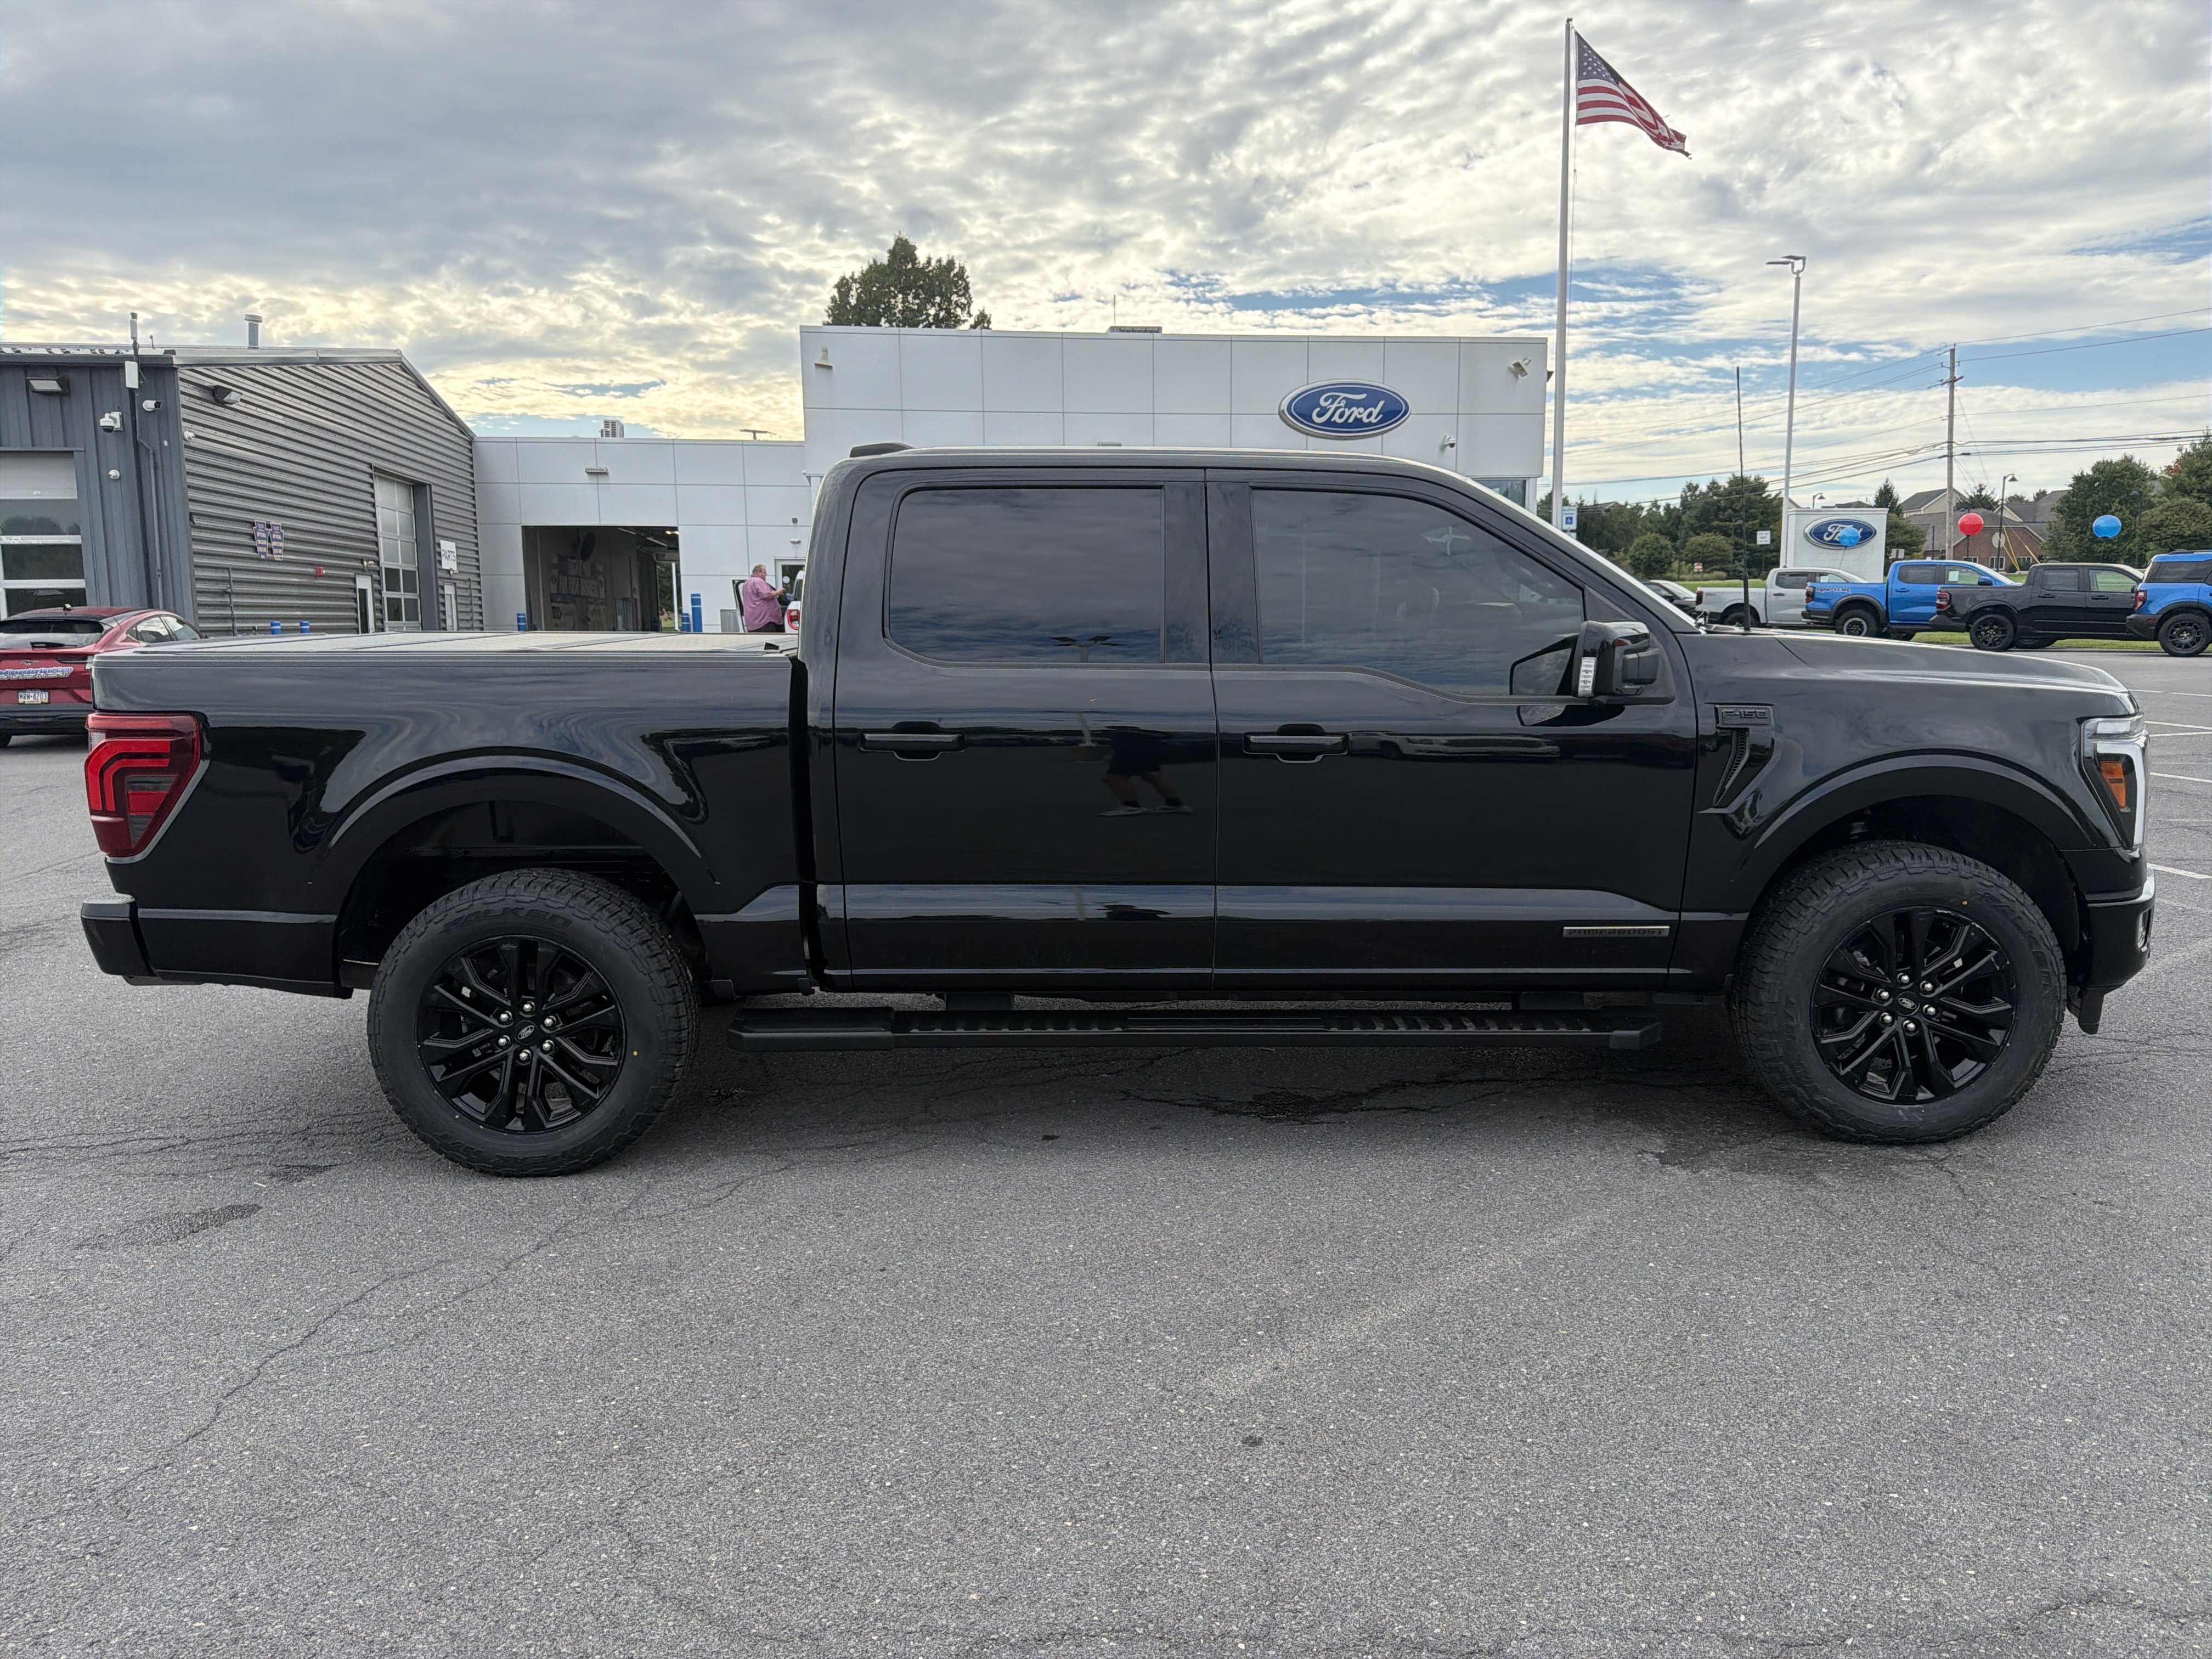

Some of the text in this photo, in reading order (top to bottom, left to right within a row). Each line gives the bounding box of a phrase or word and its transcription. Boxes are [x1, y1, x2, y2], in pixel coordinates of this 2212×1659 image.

[1312, 392, 1385, 423] Ford
[442, 549, 455, 562] PARTS
[1722, 709, 1768, 719] F-150
